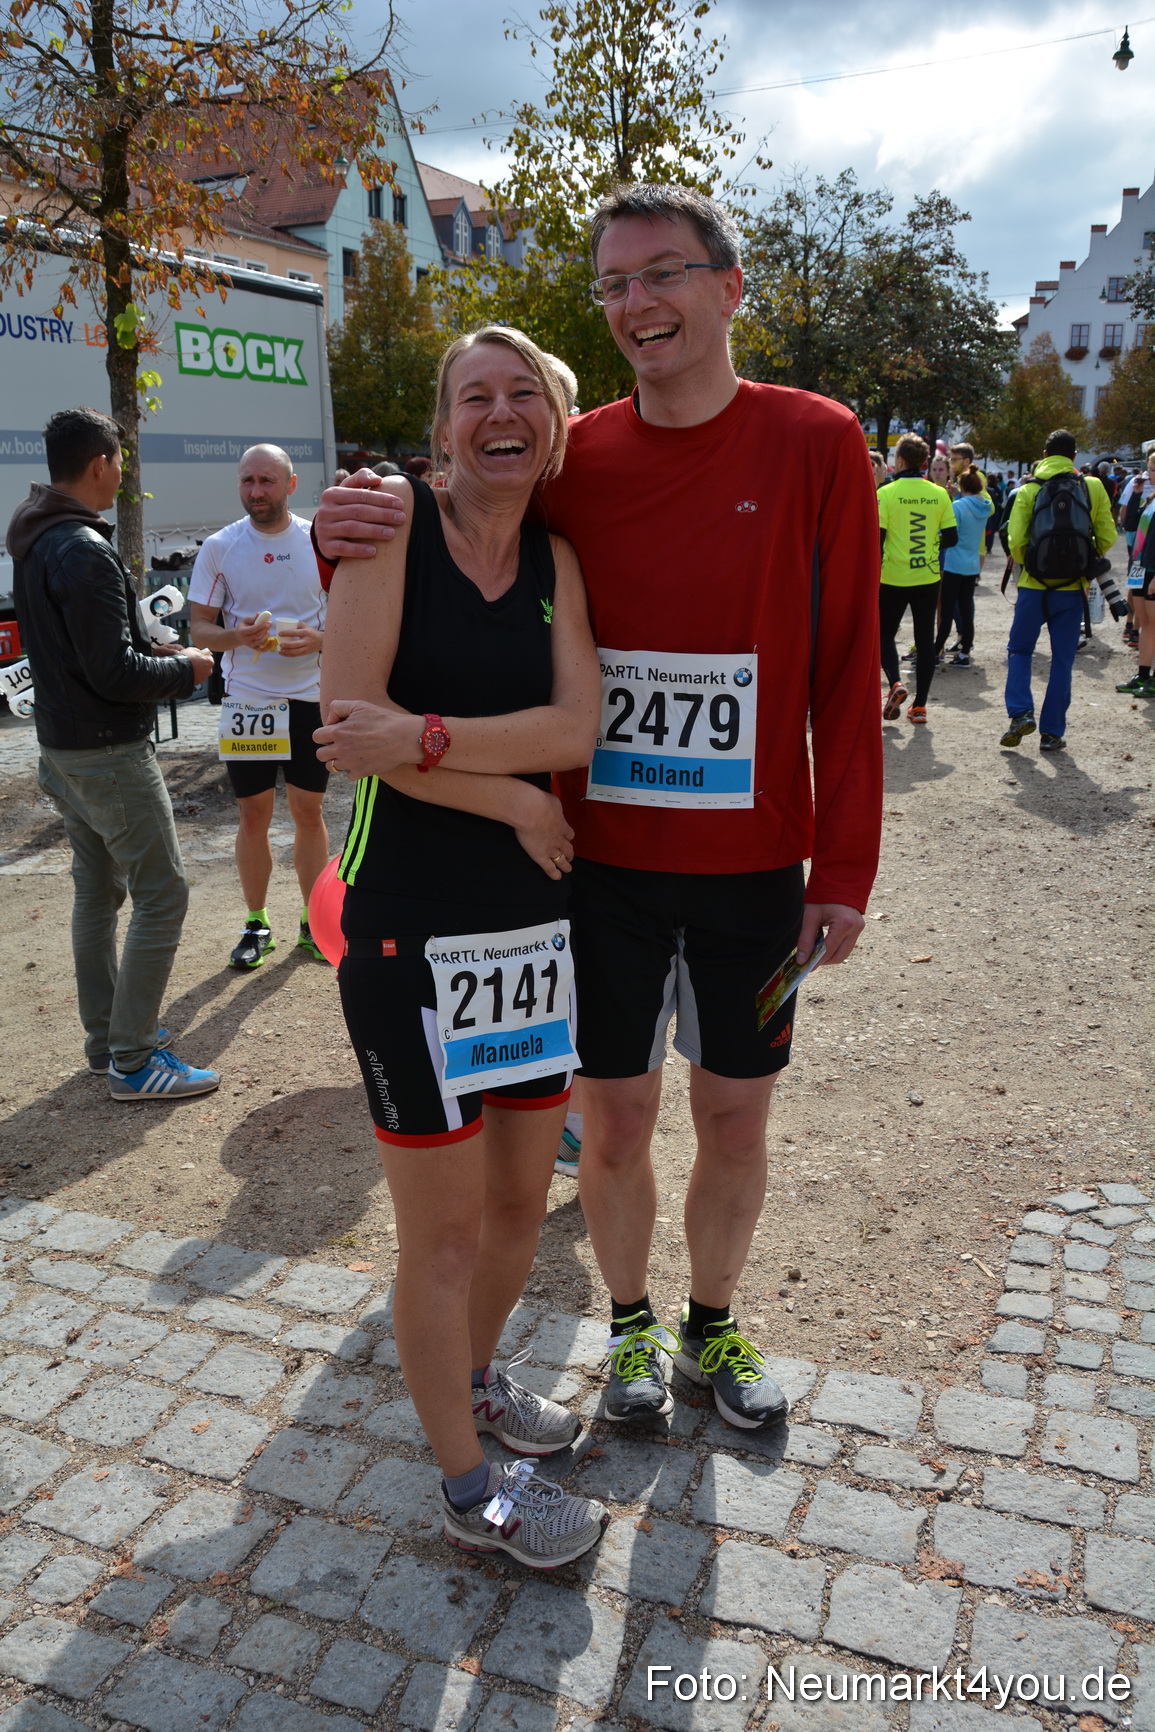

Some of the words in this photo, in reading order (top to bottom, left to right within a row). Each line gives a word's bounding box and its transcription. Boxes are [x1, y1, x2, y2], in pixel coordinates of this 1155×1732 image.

[177, 325, 304, 382] BOCK
[184, 439, 227, 459] inspired
[229, 440, 241, 459] by
[898, 497, 919, 505] Team
[909, 511, 927, 569] BMW
[277, 554, 290, 562] dpd
[648, 667, 726, 685] Neumarkt
[231, 712, 275, 736] 379
[606, 687, 740, 751] 2479
[231, 741, 277, 752] Alexander
[630, 760, 704, 787] Roland
[429, 950, 480, 965] PARTL
[483, 940, 549, 961] Neumarkt
[450, 959, 558, 1031] 2141
[471, 1034, 543, 1067] Manuela
